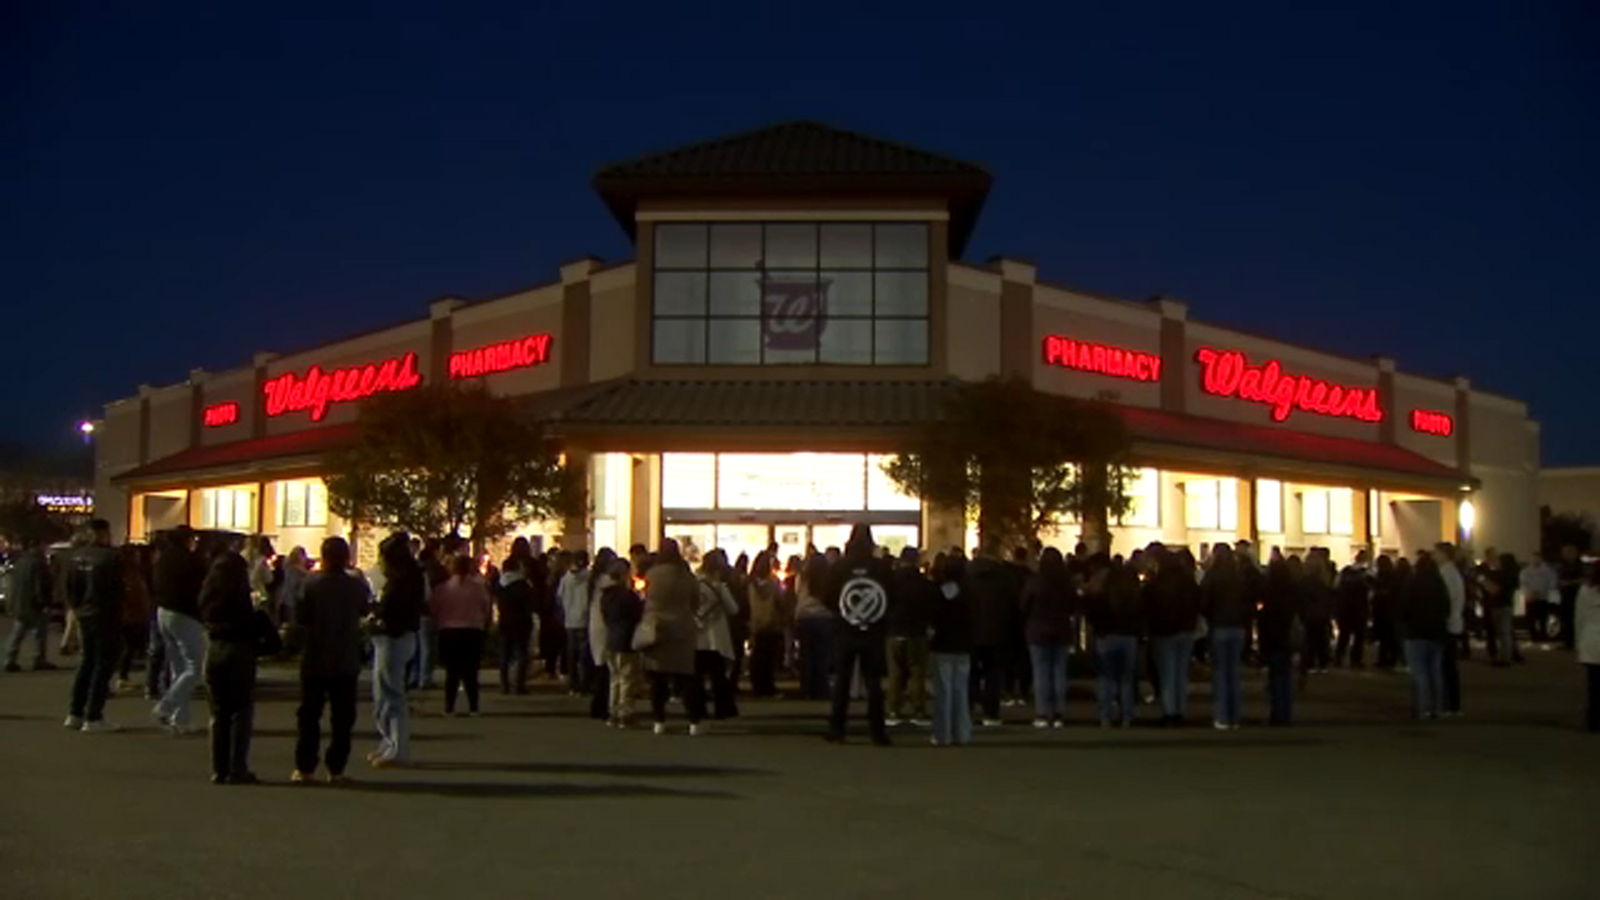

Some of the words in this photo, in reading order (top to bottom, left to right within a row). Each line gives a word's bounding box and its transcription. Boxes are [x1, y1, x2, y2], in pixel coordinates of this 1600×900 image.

[449, 334, 550, 376] PHARMACY
[1045, 336, 1162, 381] PHARMACY
[264, 354, 420, 420] Walgreens
[1197, 349, 1382, 421] Walgreens
[1413, 409, 1451, 435] PHOTO
